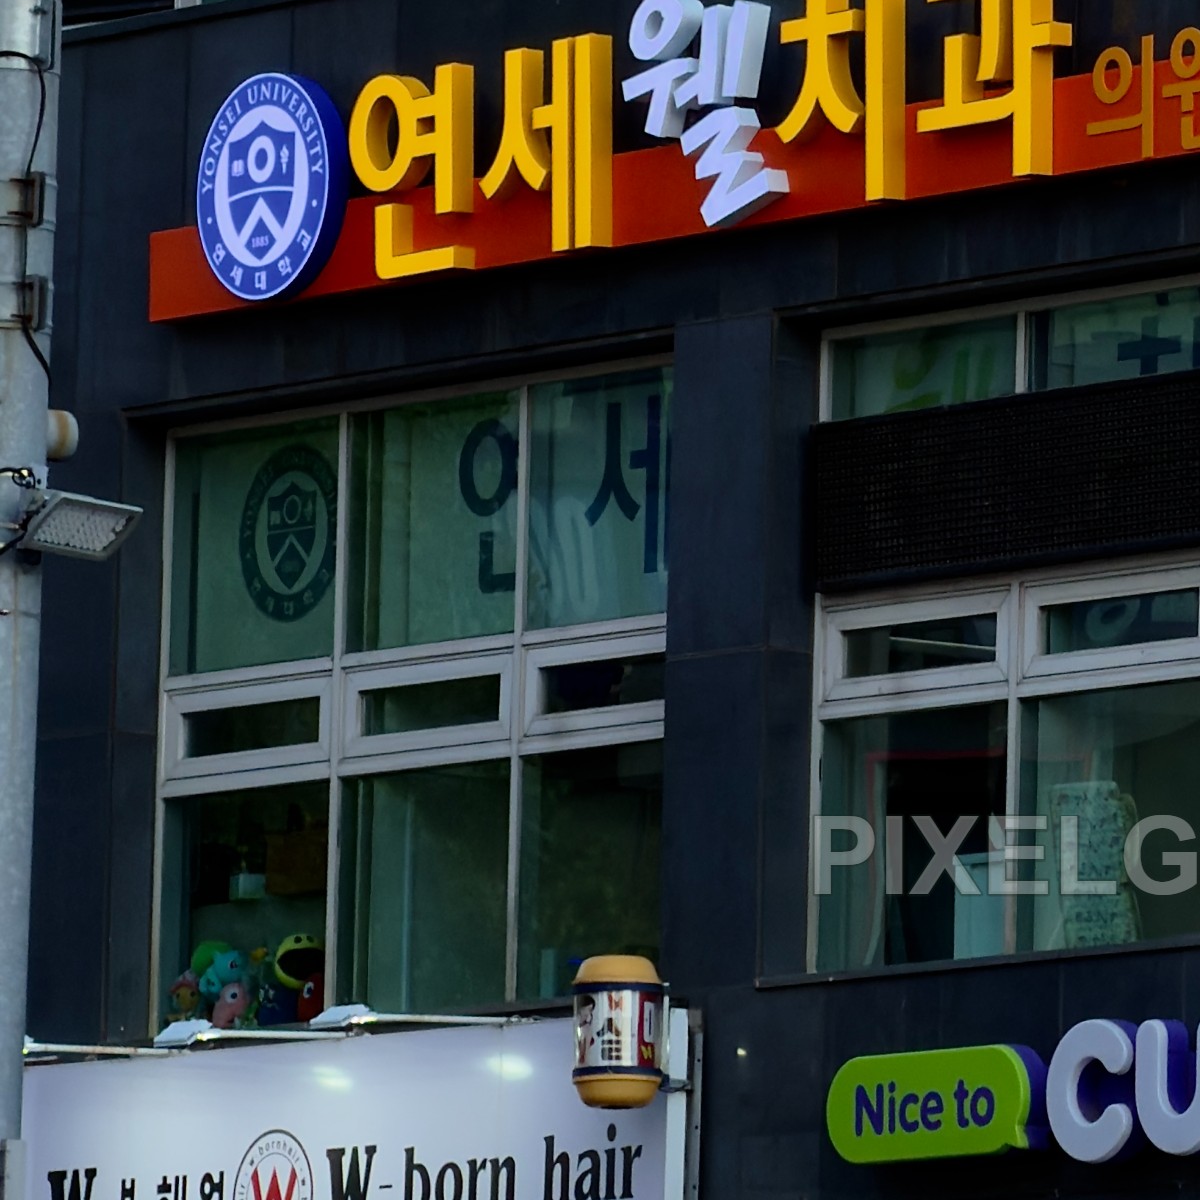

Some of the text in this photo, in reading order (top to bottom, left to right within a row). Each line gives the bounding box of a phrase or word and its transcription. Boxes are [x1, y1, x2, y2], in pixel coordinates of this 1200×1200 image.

[201, 81, 324, 195] YONSEI UNIVERSITY
[212, 228, 312, 291] 연세대학교
[853, 1079, 995, 1138] Nice to
[543, 1123, 643, 1200] hair
